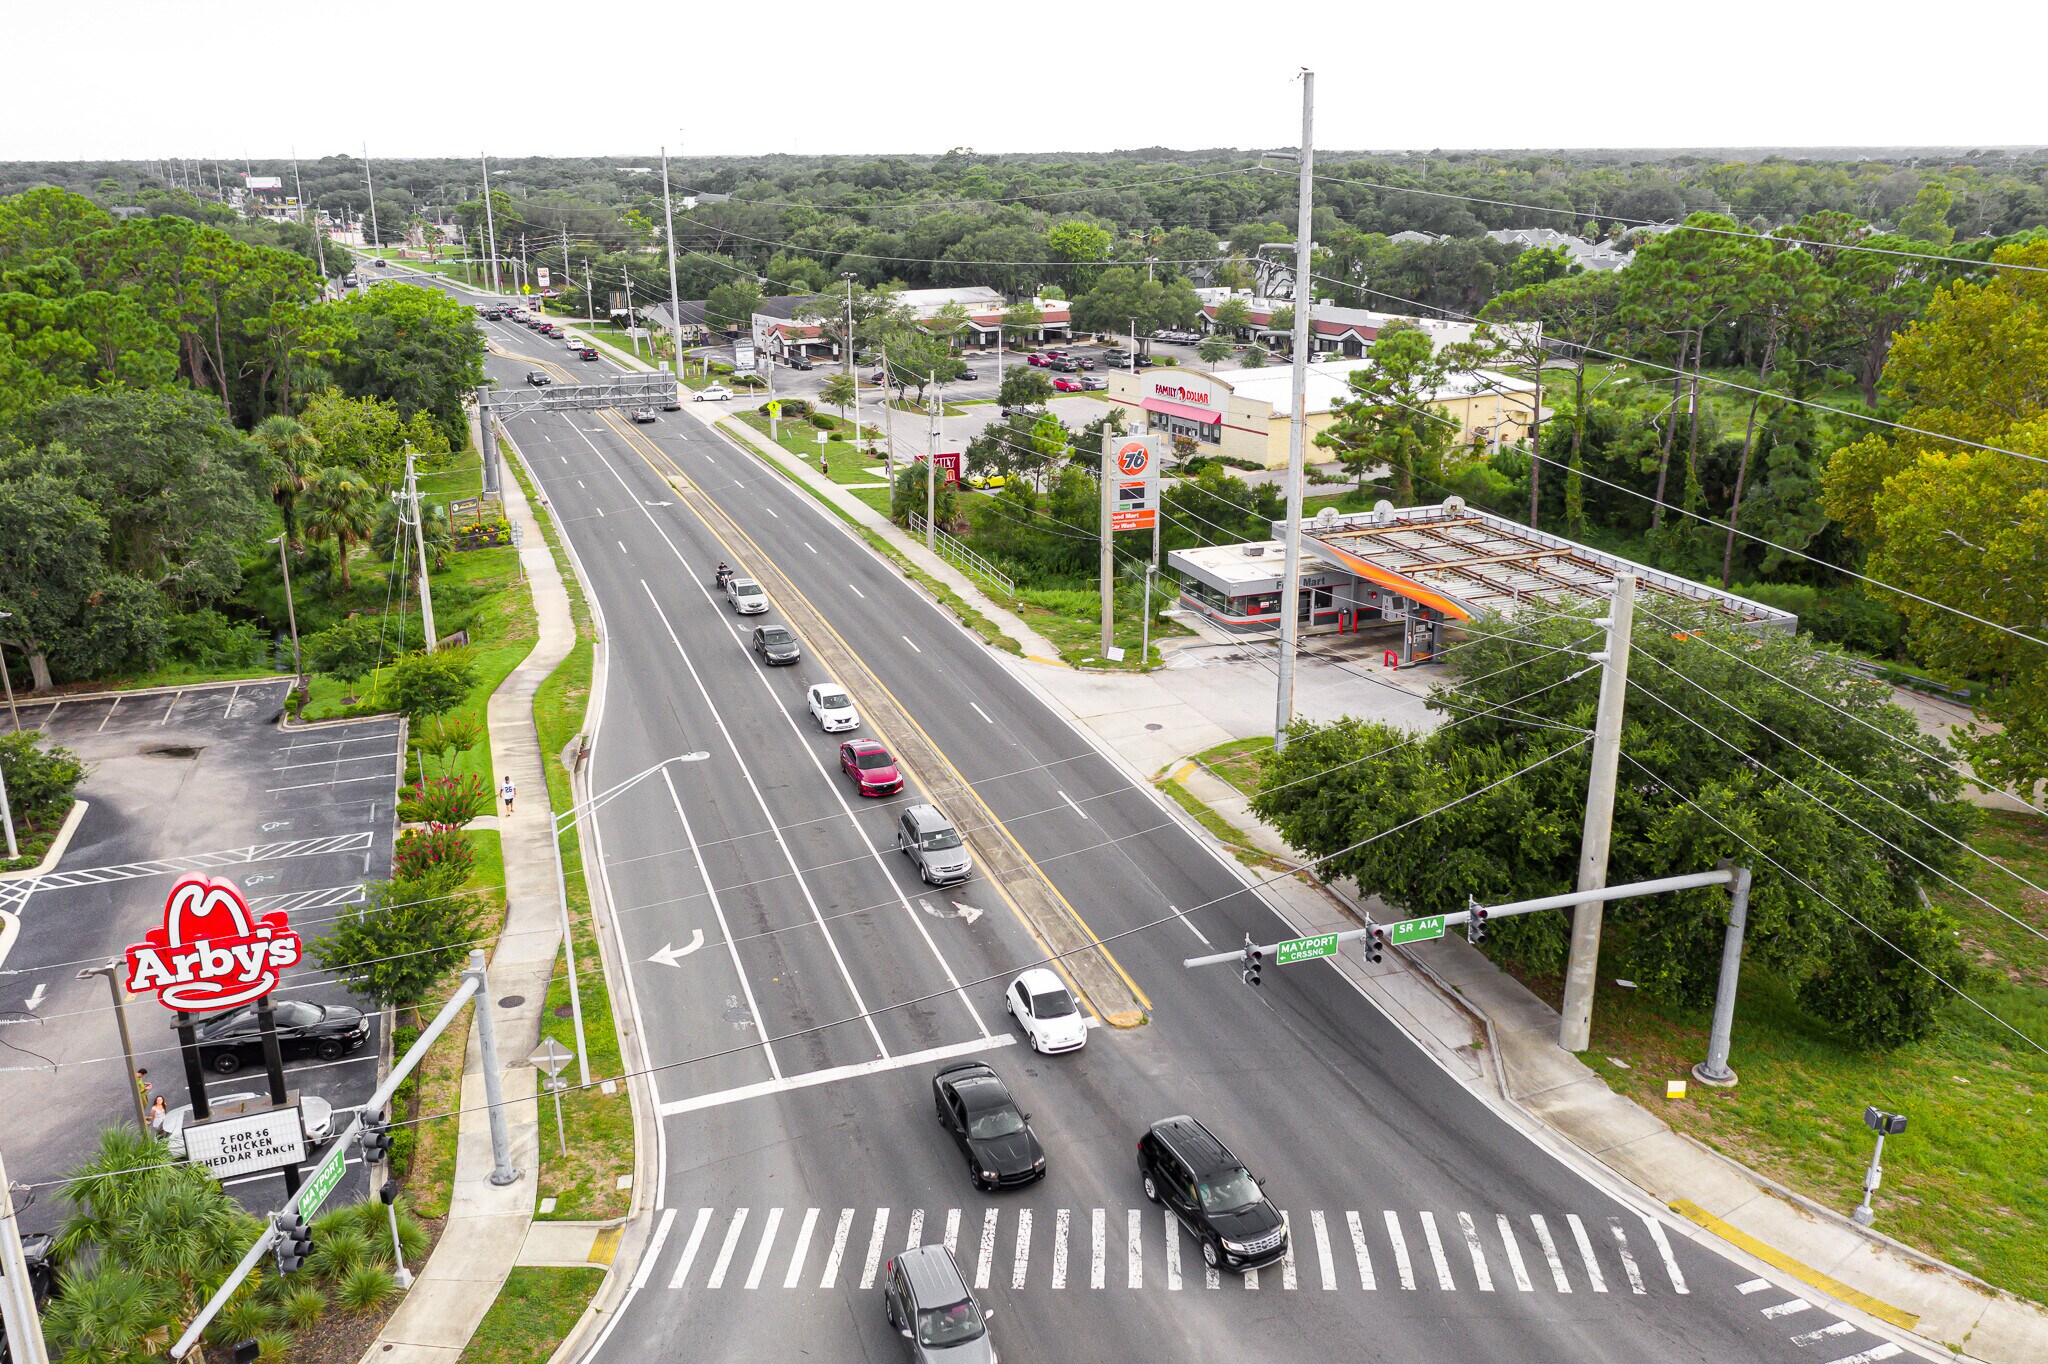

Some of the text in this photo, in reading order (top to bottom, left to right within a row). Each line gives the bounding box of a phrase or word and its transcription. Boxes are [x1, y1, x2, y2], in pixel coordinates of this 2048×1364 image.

[1155, 383, 1209, 404] FAMILY DOLLAR
[934, 456, 956, 468] MILY
[1123, 449, 1146, 470] 76
[1303, 576, 1326, 586] Mart
[1398, 923, 1413, 934] SR
[1280, 935, 1335, 954] MAYPORT
[1290, 947, 1324, 960] CRSSNG
[130, 928, 298, 990] Arby's
[220, 1128, 269, 1145] 2 FOR $6
[222, 1137, 273, 1154] CHICKEN
[201, 1143, 295, 1168] HEDDAR RANCH
[302, 1155, 339, 1209] MAYPORT
